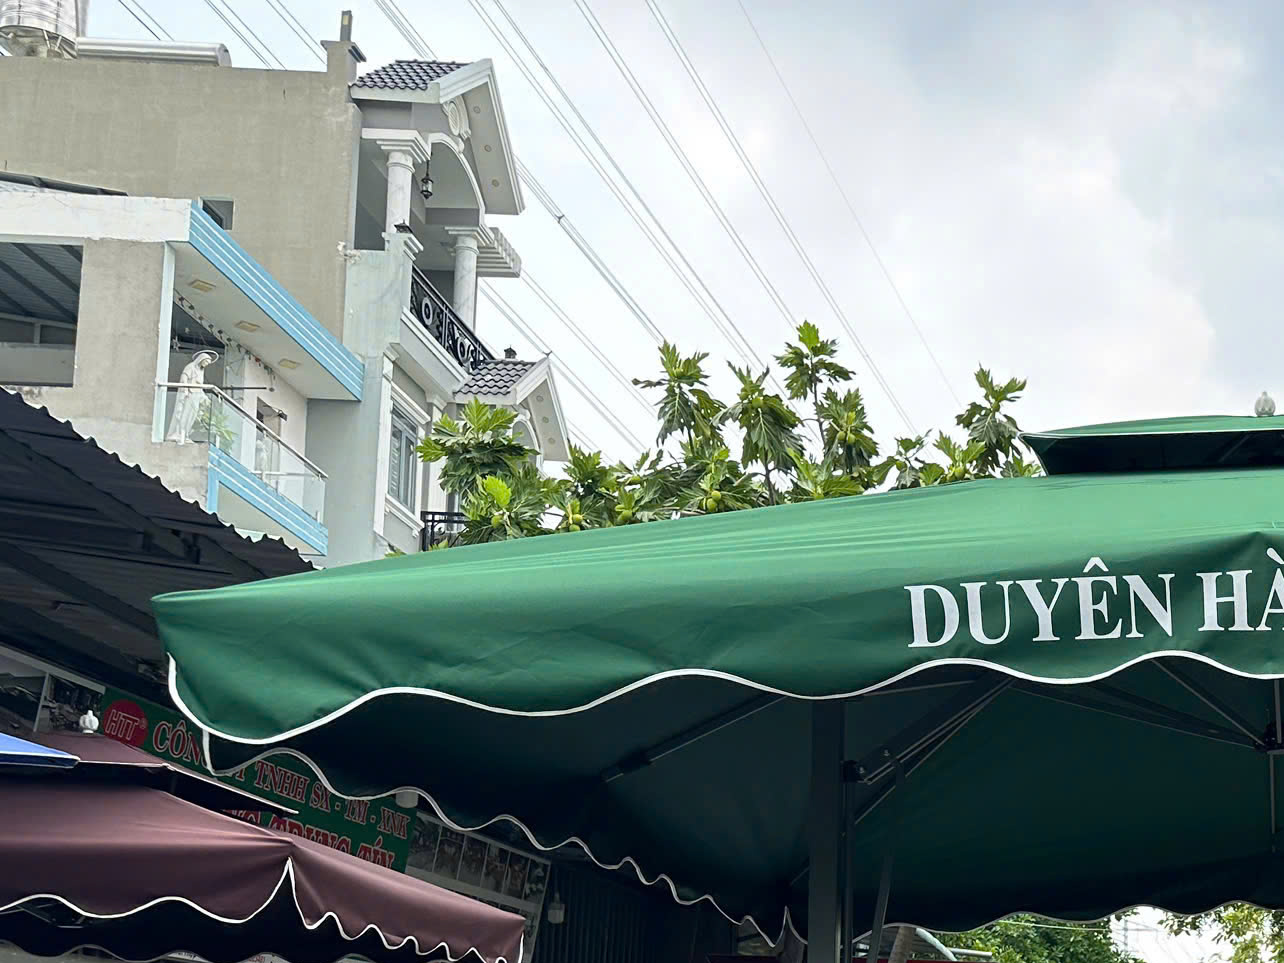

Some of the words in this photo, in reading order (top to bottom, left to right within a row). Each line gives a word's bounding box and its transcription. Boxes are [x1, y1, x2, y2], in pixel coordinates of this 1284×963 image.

[903, 556, 1175, 648] DUYÊN
[153, 719, 208, 769] CÔN
[255, 759, 310, 803] TNHH
[309, 781, 331, 812] SX
[377, 807, 411, 840] XNK
